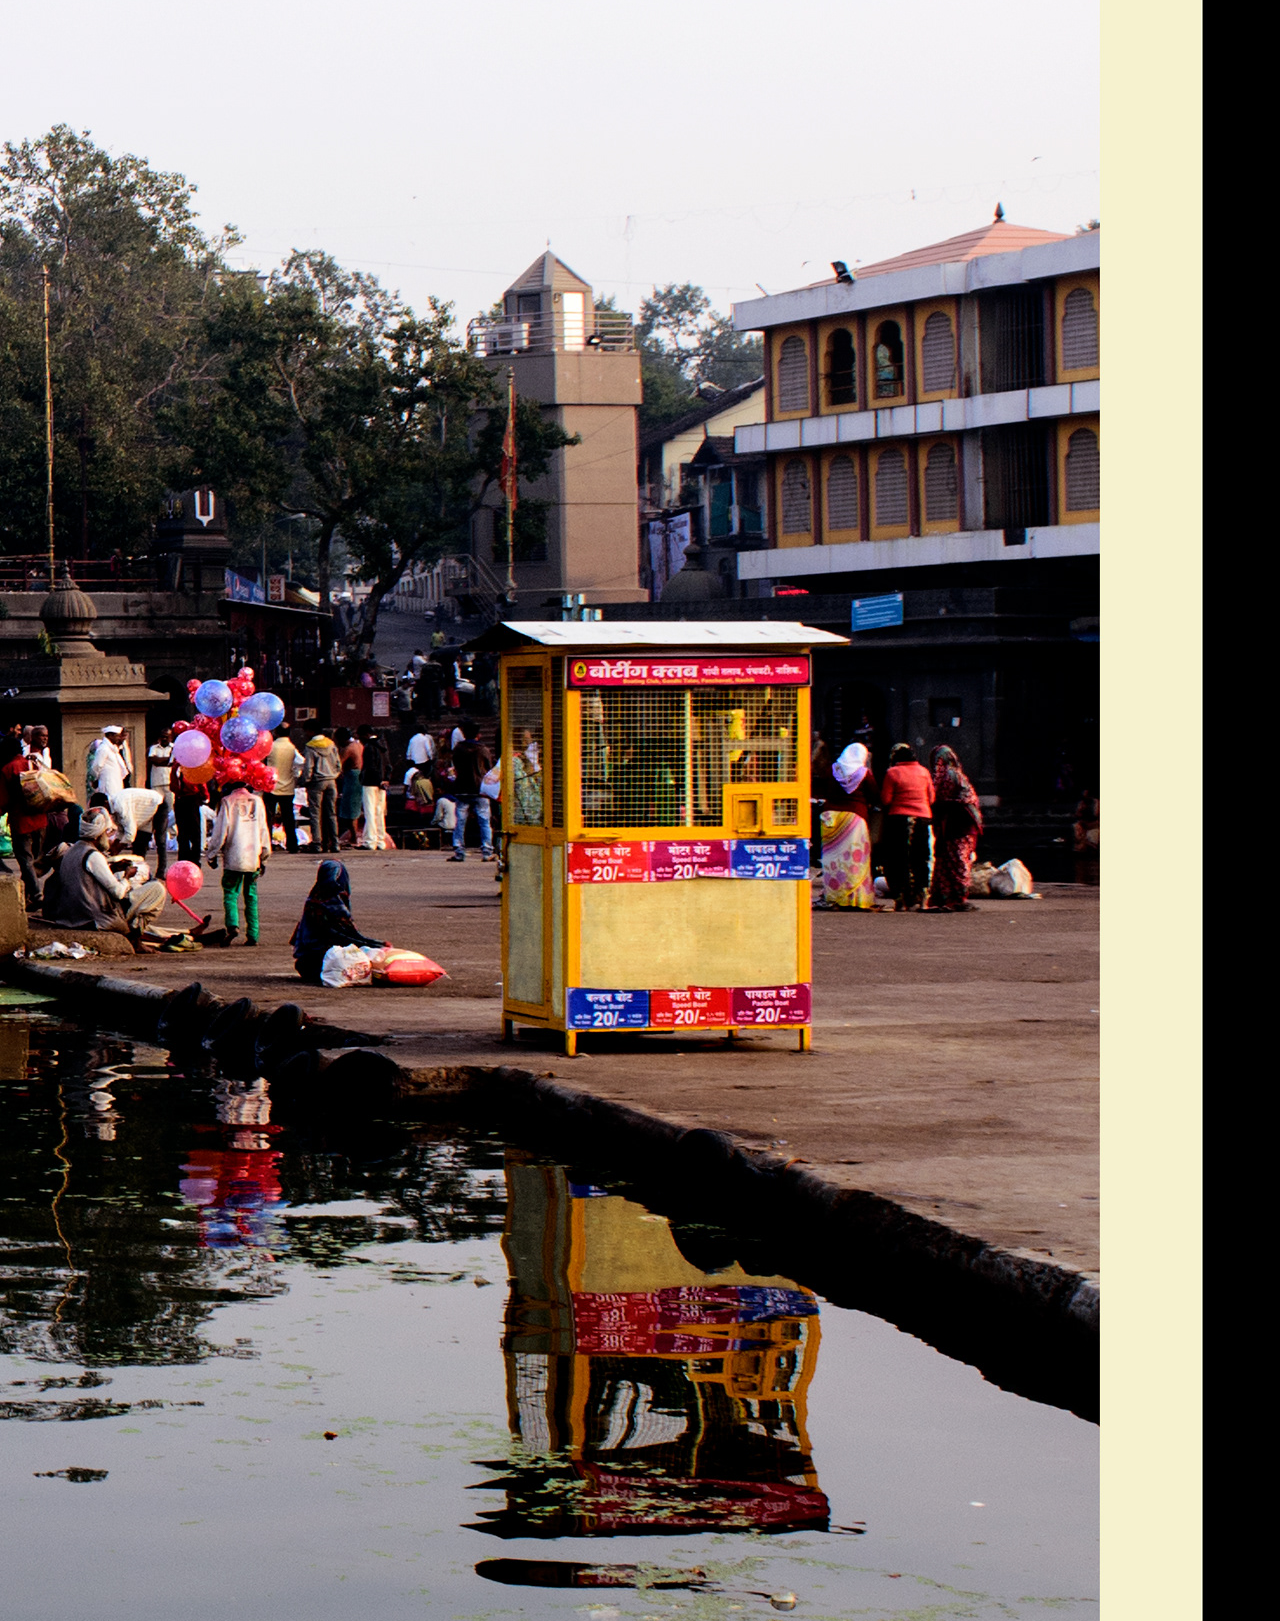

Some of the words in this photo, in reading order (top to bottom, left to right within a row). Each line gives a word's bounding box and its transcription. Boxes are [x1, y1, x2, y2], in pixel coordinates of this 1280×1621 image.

[588, 660, 649, 678] बोटींग
[651, 664, 699, 678] क्लब
[592, 866, 625, 881] 20/-
[755, 862, 787, 878] 20/-
[593, 1011, 625, 1027] 20/-
[673, 1009, 706, 1024] 20/-
[755, 1007, 787, 1023] 20/-
